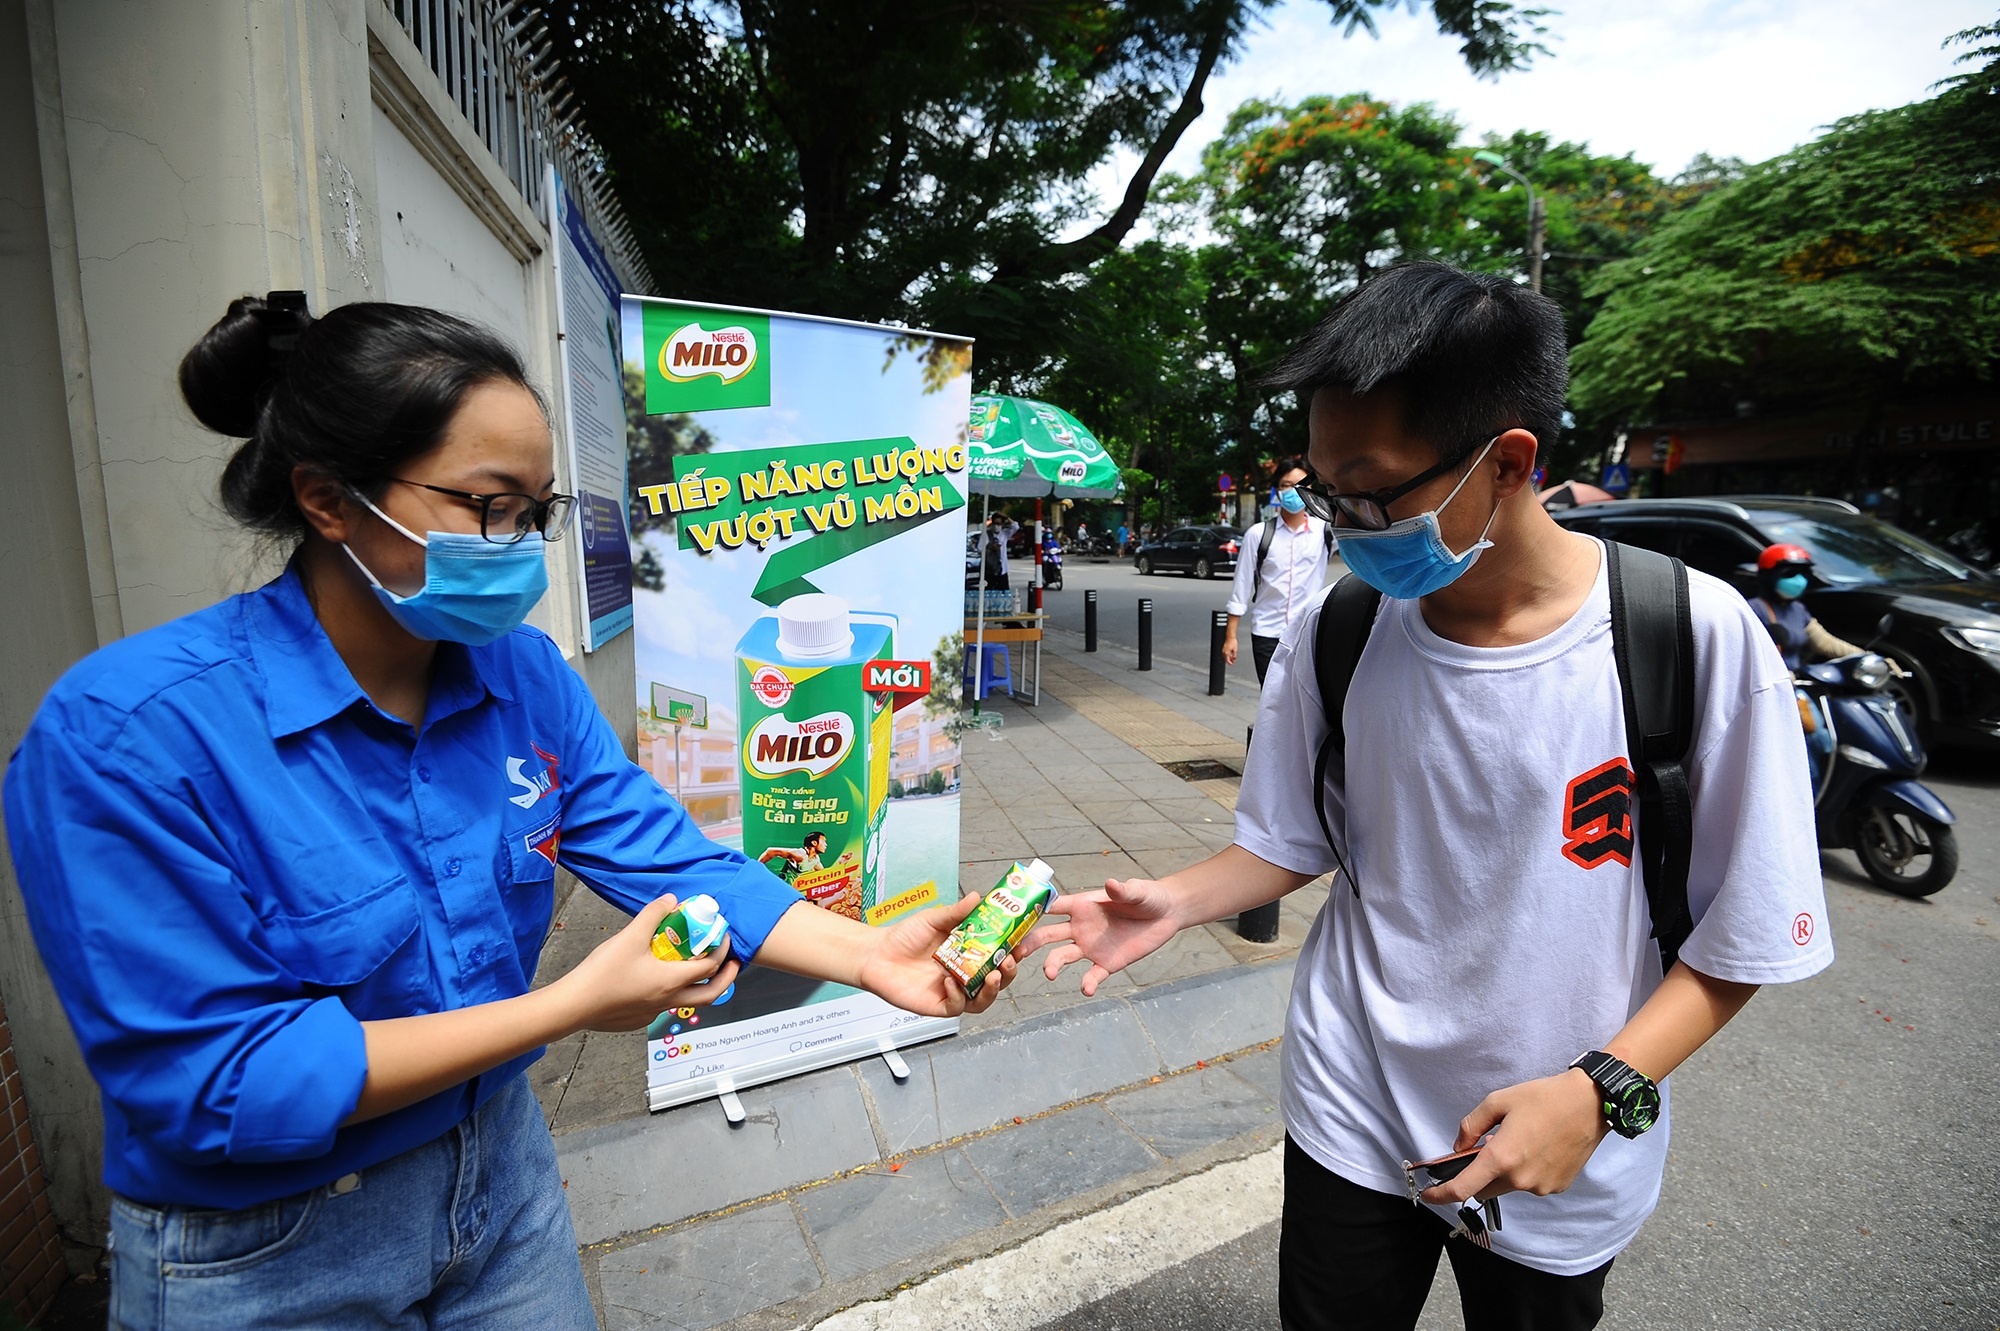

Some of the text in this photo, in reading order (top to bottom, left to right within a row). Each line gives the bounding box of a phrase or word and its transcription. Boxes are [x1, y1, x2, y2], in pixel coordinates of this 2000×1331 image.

[673, 342, 748, 367] MILO
[639, 445, 966, 515] TIẾP NĂNG LƯỢNG
[1062, 467, 1083, 477] MILO
[689, 484, 943, 551] VƯỢT VŨ MÔN
[870, 664, 920, 688] MỚI
[757, 732, 843, 763] MILO
[752, 792, 838, 811] Bữa sáng
[764, 809, 796, 824] Cân
[796, 869, 841, 888] Protein
[811, 881, 841, 897] Fiber
[874, 888, 930, 919] #Protein
[992, 892, 1021, 913] MILO
[695, 1008, 851, 1051] Khoa Nguyen Hoang Anh and 2k others
[804, 1032, 843, 1049] Comment
[706, 1062, 725, 1073] Like
